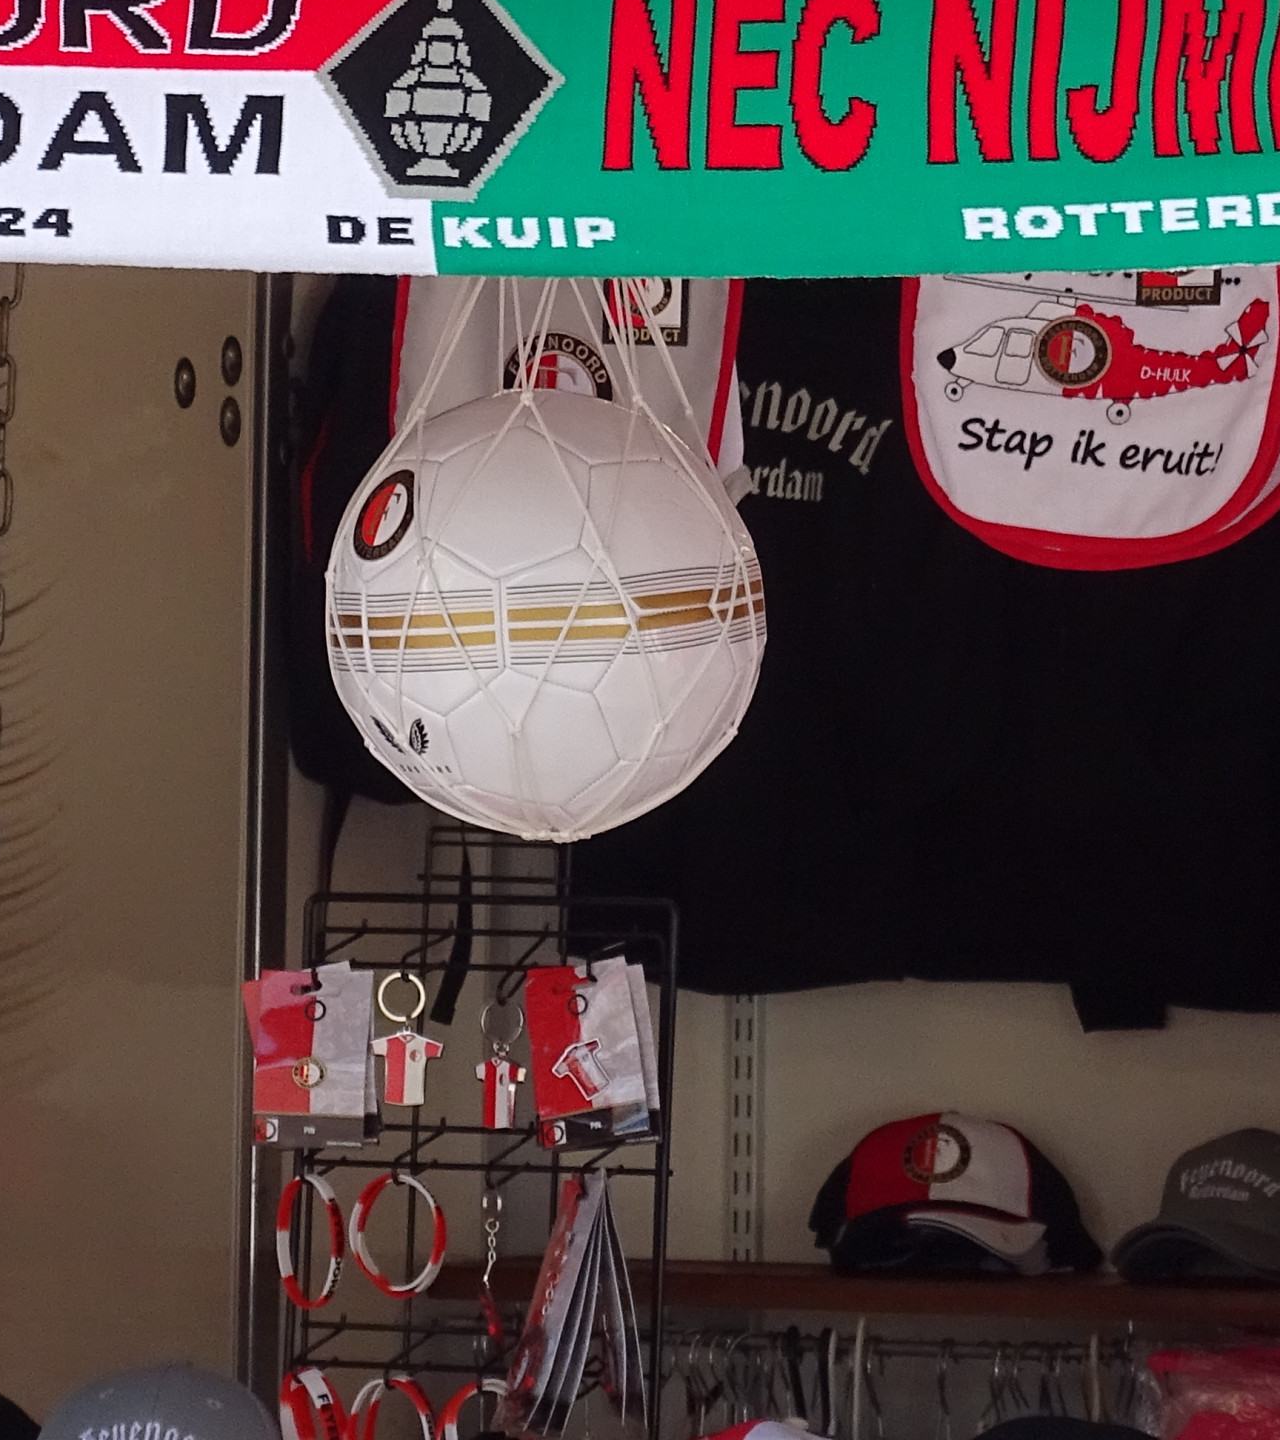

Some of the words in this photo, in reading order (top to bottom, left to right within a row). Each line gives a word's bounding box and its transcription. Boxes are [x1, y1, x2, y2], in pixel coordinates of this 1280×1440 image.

[325, 215, 416, 247] DE
[442, 215, 618, 250] KUIP
[1141, 286, 1214, 302] PRODUCT
[1140, 365, 1192, 383] D-HULK
[958, 418, 1054, 471] Stap
[1070, 430, 1106, 468] ik
[1119, 442, 1224, 478] eruit!
